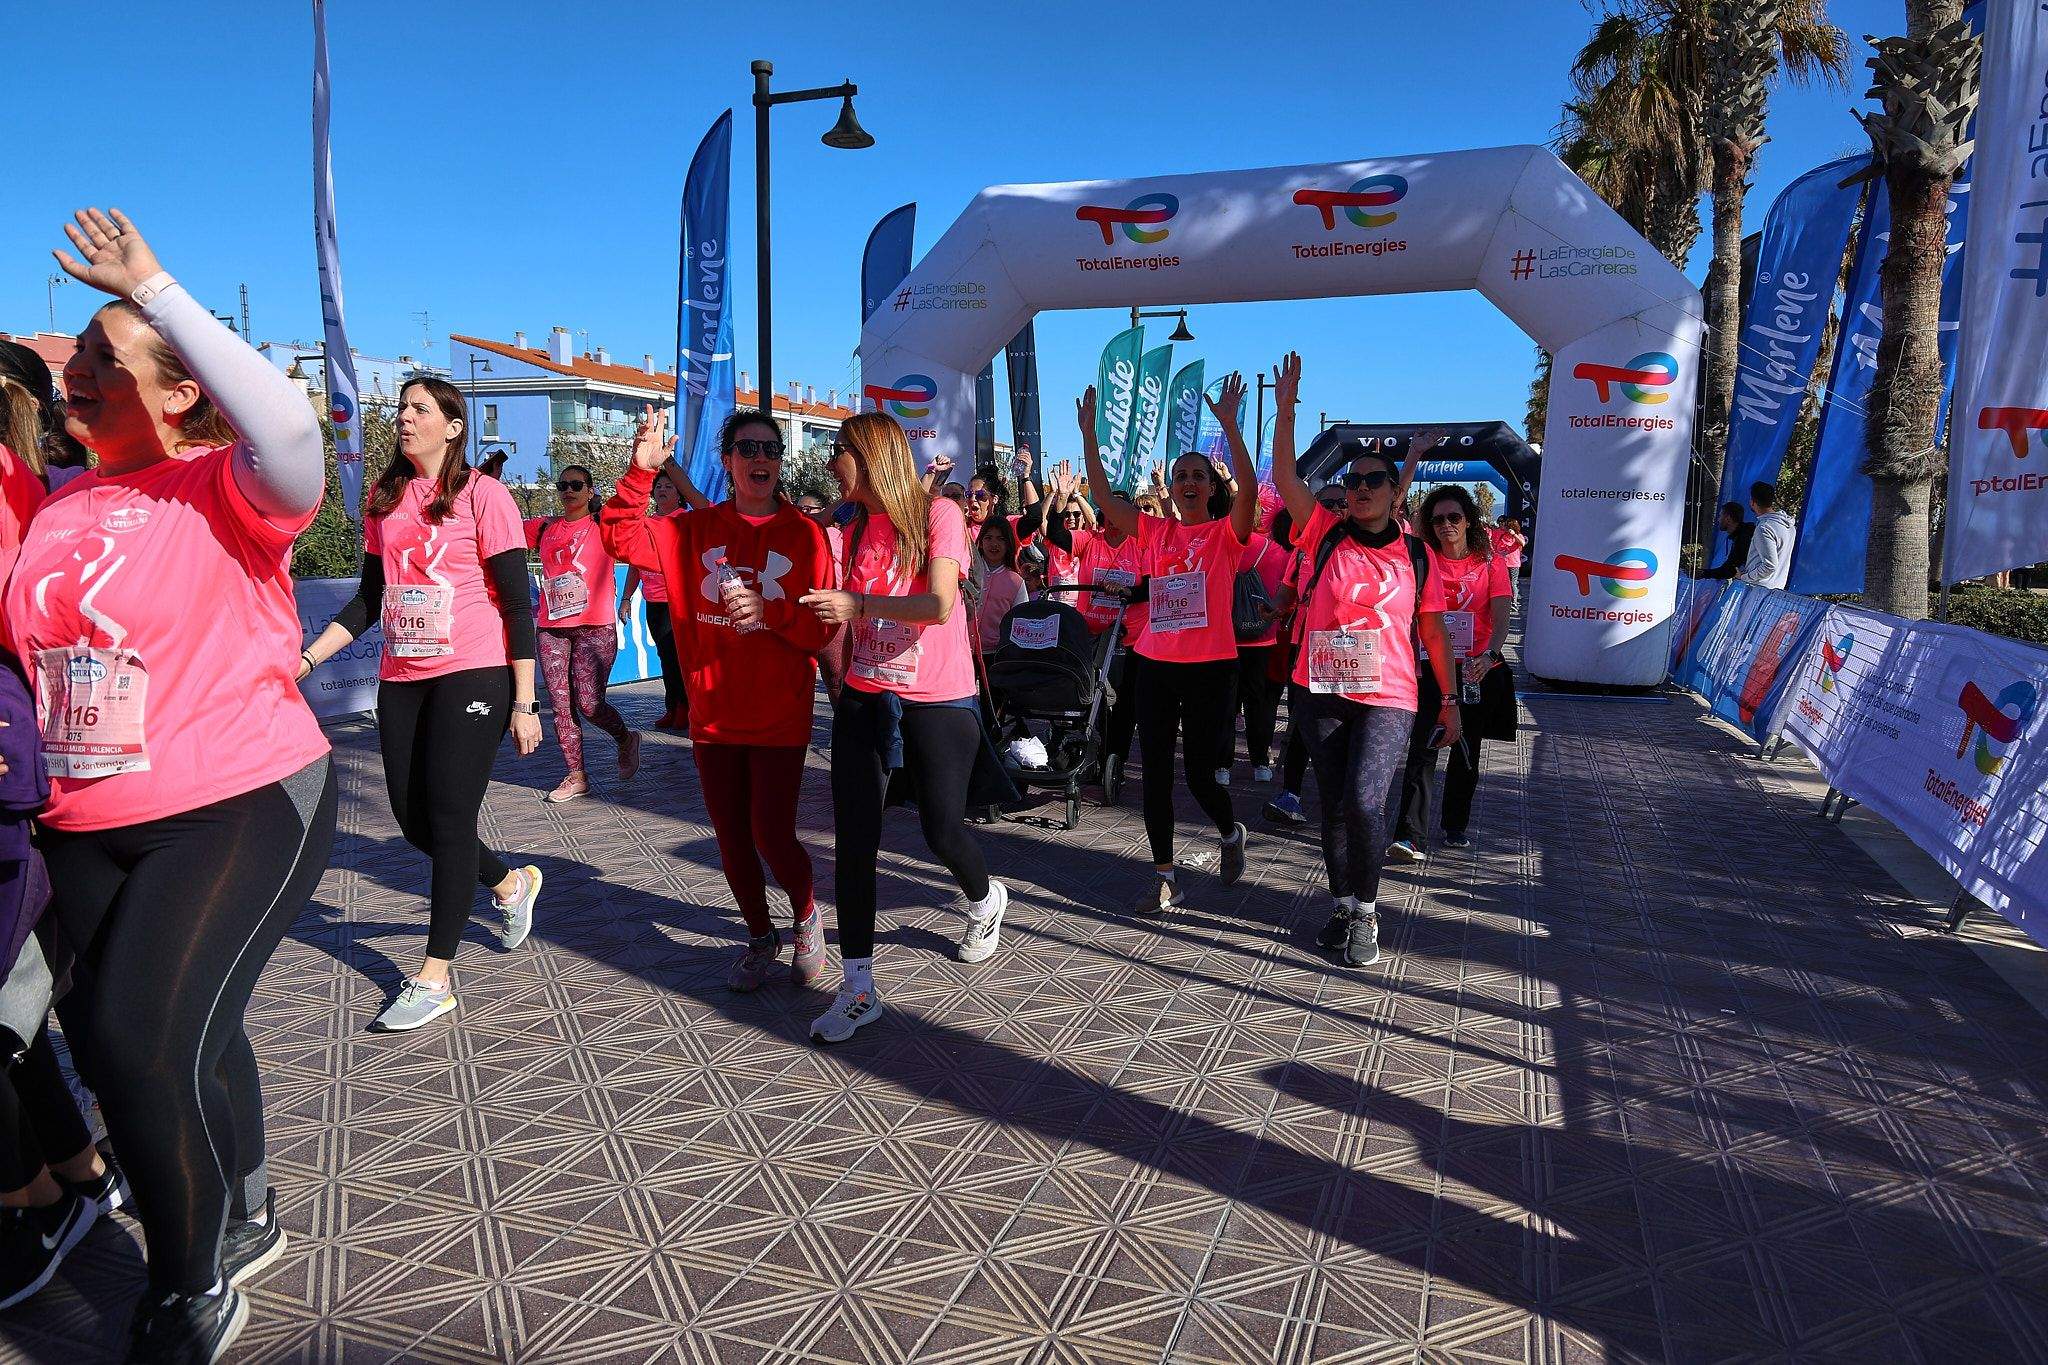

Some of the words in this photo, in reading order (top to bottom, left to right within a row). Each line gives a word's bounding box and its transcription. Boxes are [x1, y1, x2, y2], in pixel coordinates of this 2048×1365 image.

[1292, 238, 1407, 258] TotalEnergies
[1076, 254, 1180, 271] TotalEnergies
[1539, 262, 1637, 279] LasCarreras
[911, 297, 987, 310] LasCarreras
[682, 238, 732, 397] Marlene
[1737, 272, 1818, 425] Marlene
[1098, 359, 1135, 486] Batiste
[1569, 415, 1674, 431] TotalEnergies
[1562, 488, 1666, 502] totalenergies.es
[559, 591, 574, 601] 016
[1168, 598, 1188, 608] 016
[697, 612, 731, 626] UNDER
[1550, 604, 1654, 625] TotalEnergies
[400, 617, 425, 628] 016
[870, 640, 896, 653] 016
[1333, 659, 1359, 668] 016
[320, 674, 380, 691] totalenergi
[90, 746, 123, 754] VALENCIA
[81, 760, 127, 770] Santander
[1923, 767, 1990, 828] TotalEnergies
